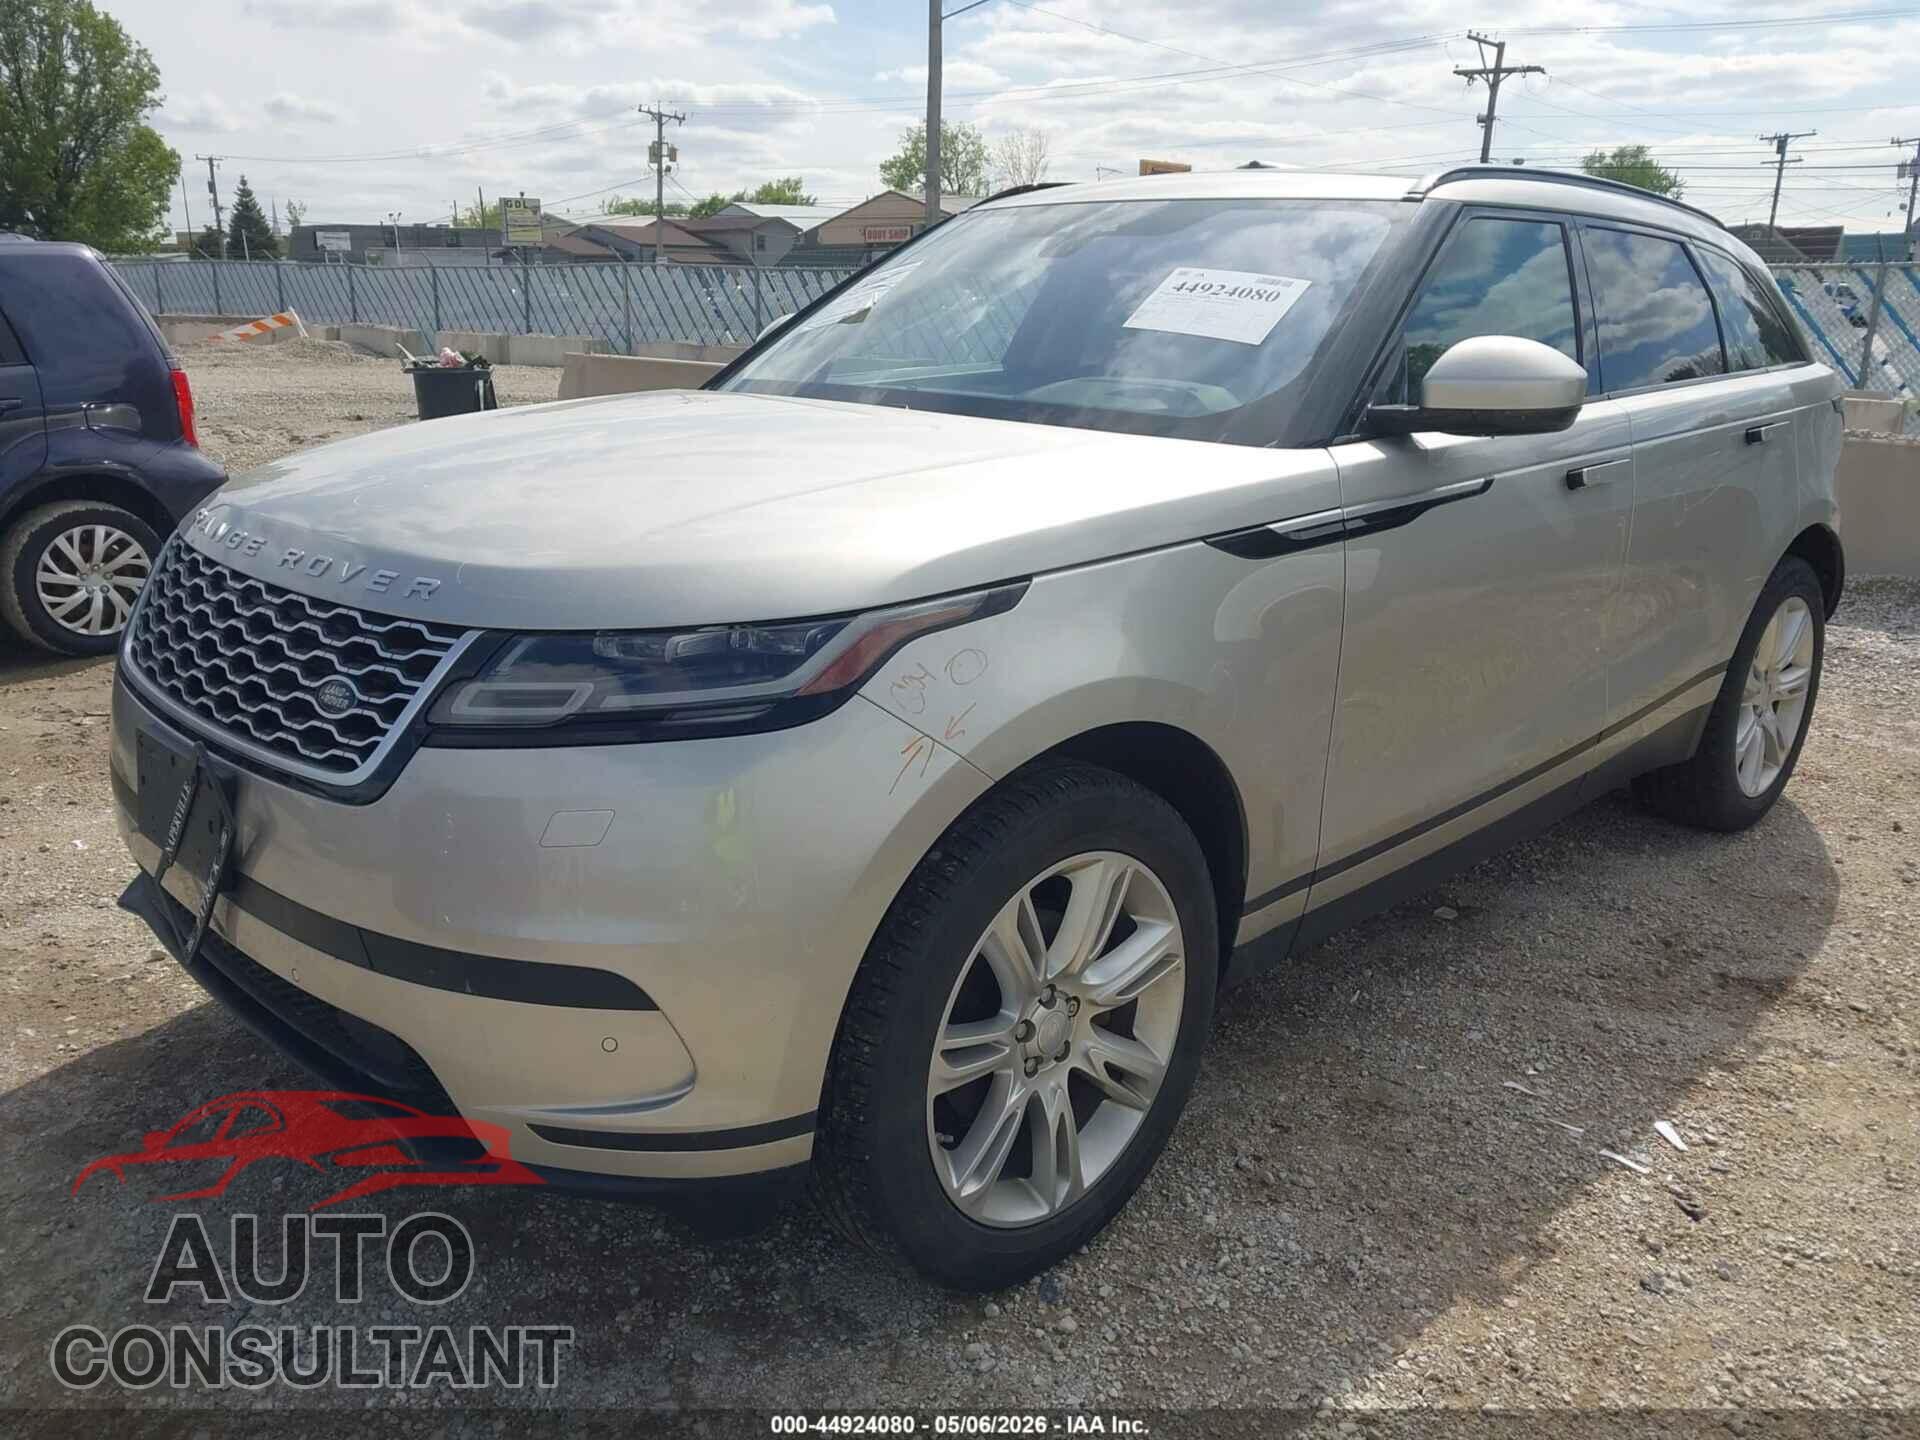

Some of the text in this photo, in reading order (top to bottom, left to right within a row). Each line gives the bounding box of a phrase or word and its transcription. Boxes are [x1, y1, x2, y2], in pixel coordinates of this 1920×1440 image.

[1172, 281, 1281, 302] 44924080
[195, 507, 441, 601] RANGE ROVER
